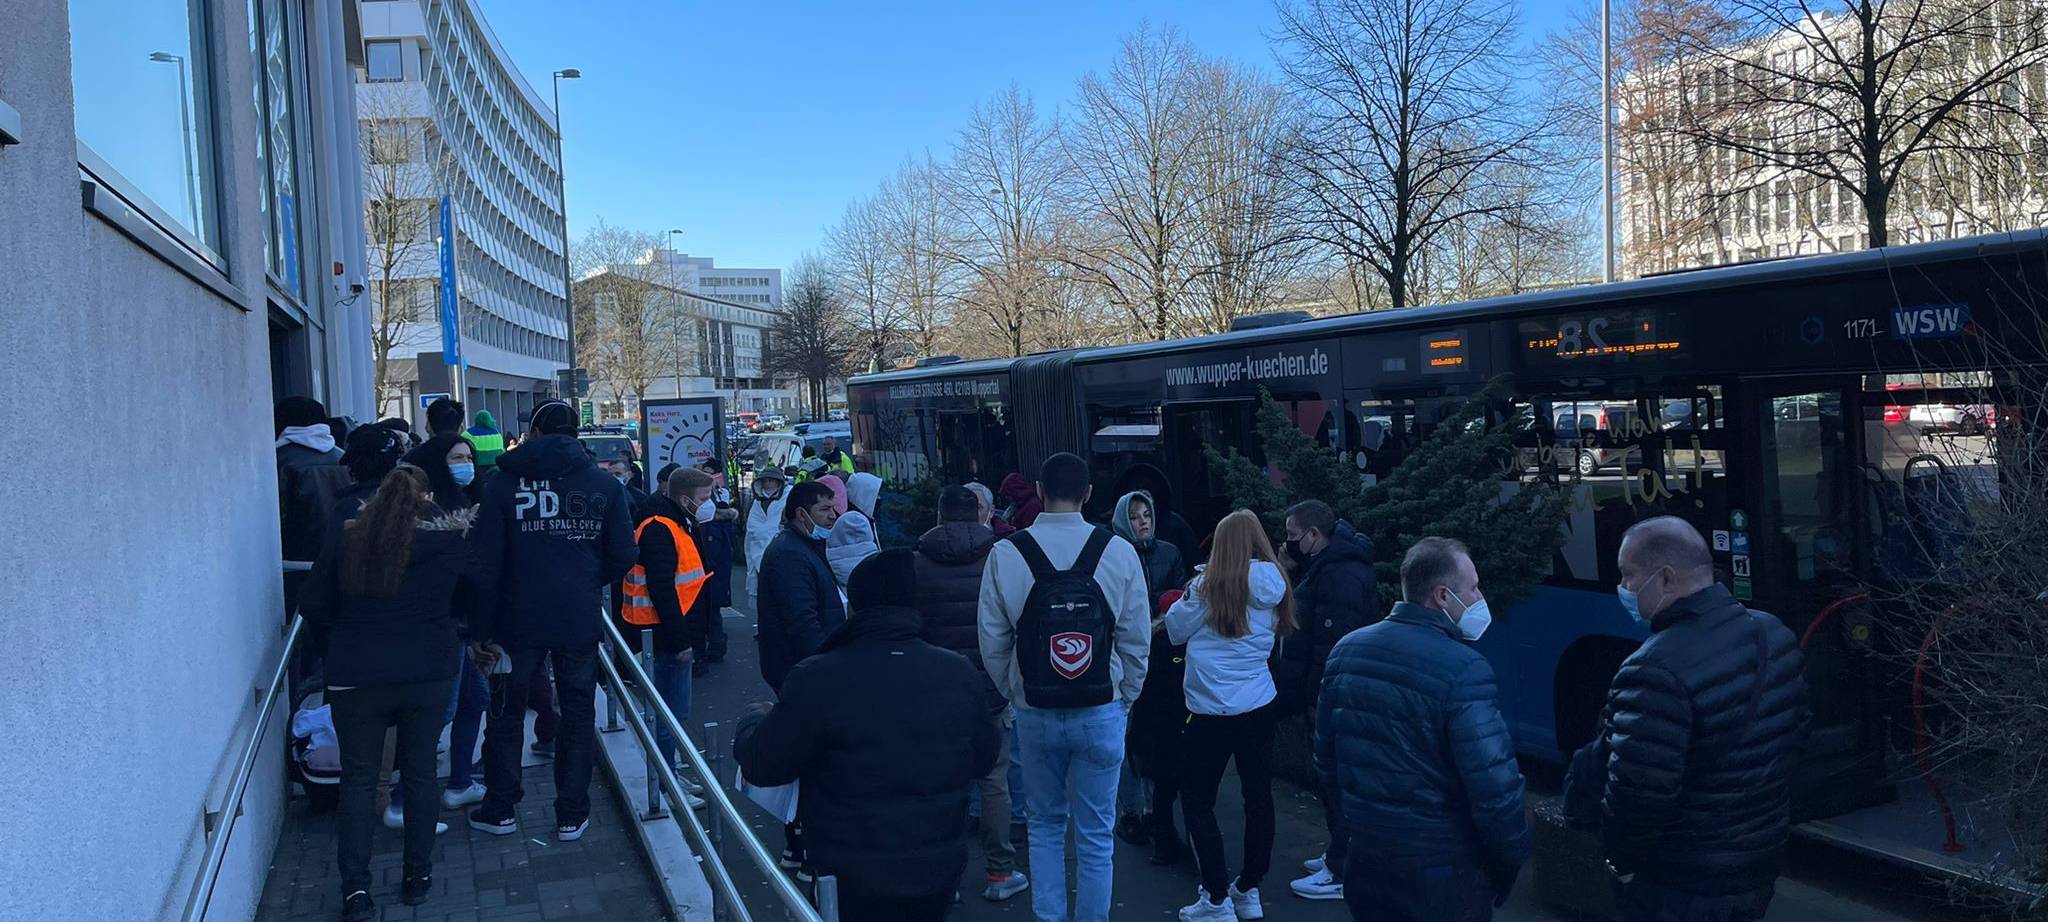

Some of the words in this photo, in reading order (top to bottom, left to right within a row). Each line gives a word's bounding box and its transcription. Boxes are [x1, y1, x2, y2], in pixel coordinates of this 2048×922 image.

[1844, 319, 1876, 339] 1171
[1895, 308, 1959, 335] WSW
[1166, 348, 1328, 387] www.wupper-kuechen.de
[972, 379, 1000, 398] Wuppertal
[515, 491, 559, 520] PD
[521, 520, 545, 531] BLUE
[548, 518, 577, 530] SPACE
[579, 519, 602, 530] CREW
